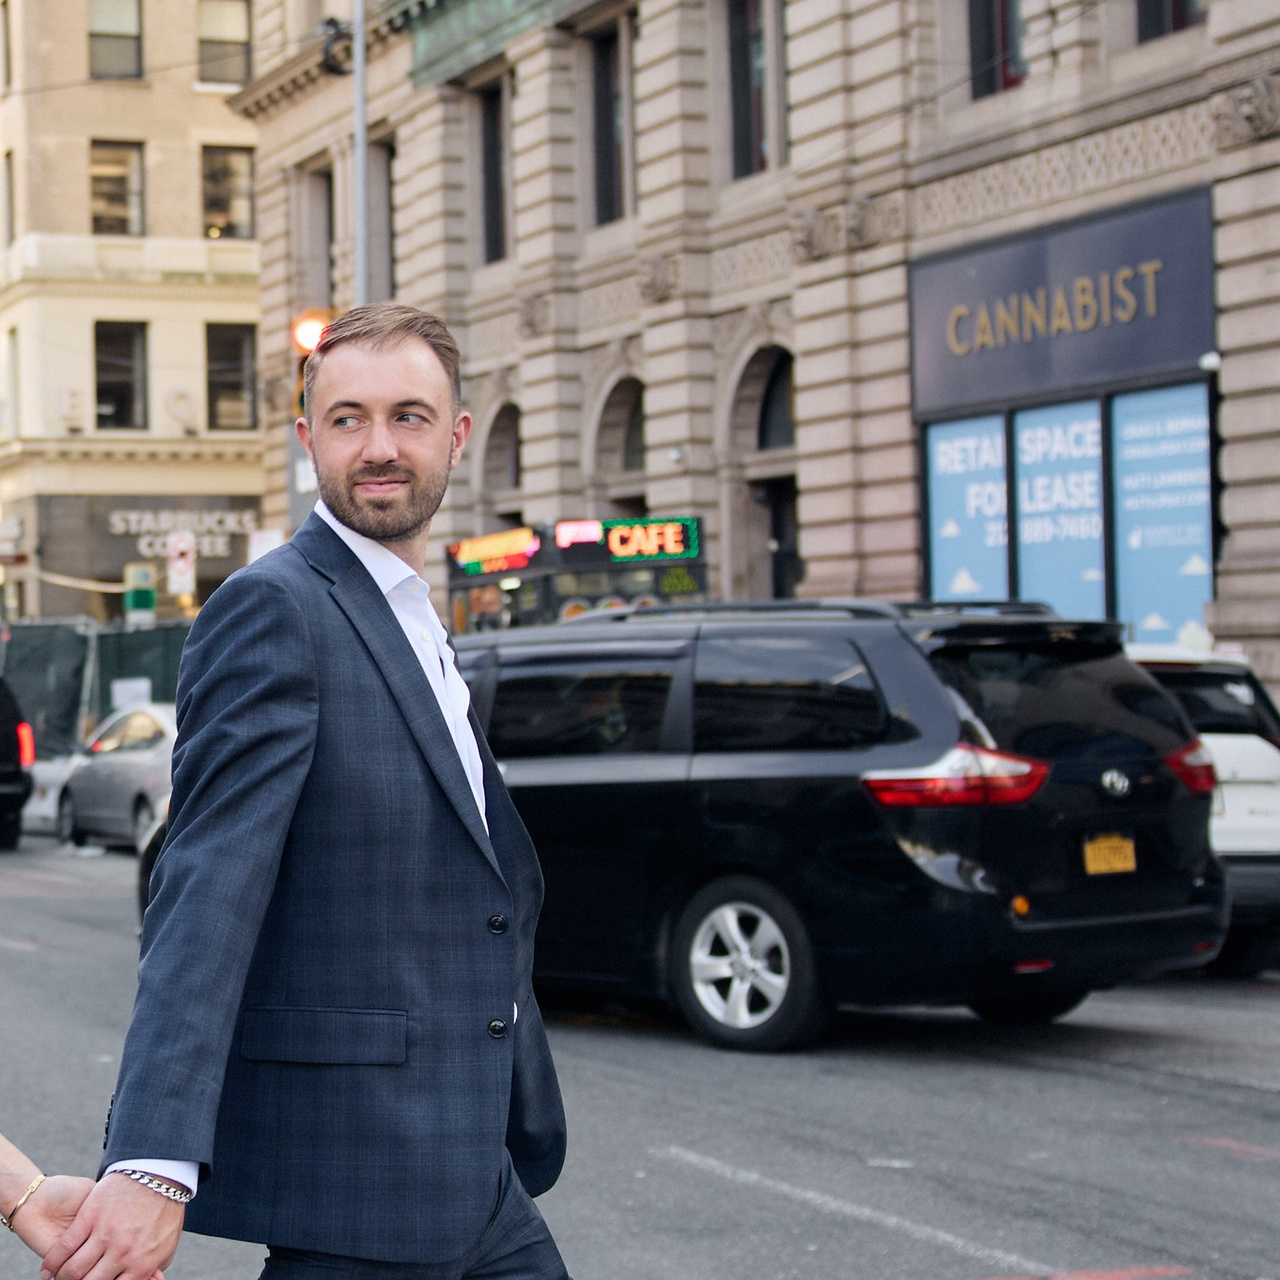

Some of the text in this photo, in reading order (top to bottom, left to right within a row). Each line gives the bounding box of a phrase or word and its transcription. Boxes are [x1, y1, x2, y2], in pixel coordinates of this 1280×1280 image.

[948, 261, 1161, 355] CANNABIST
[936, 433, 1006, 475] RETAI
[1021, 420, 1103, 465] SPACE
[1021, 471, 1100, 514] LEASE
[109, 510, 257, 536] STARBUCKS
[608, 522, 685, 558] CAFE
[137, 534, 230, 558] COEE
